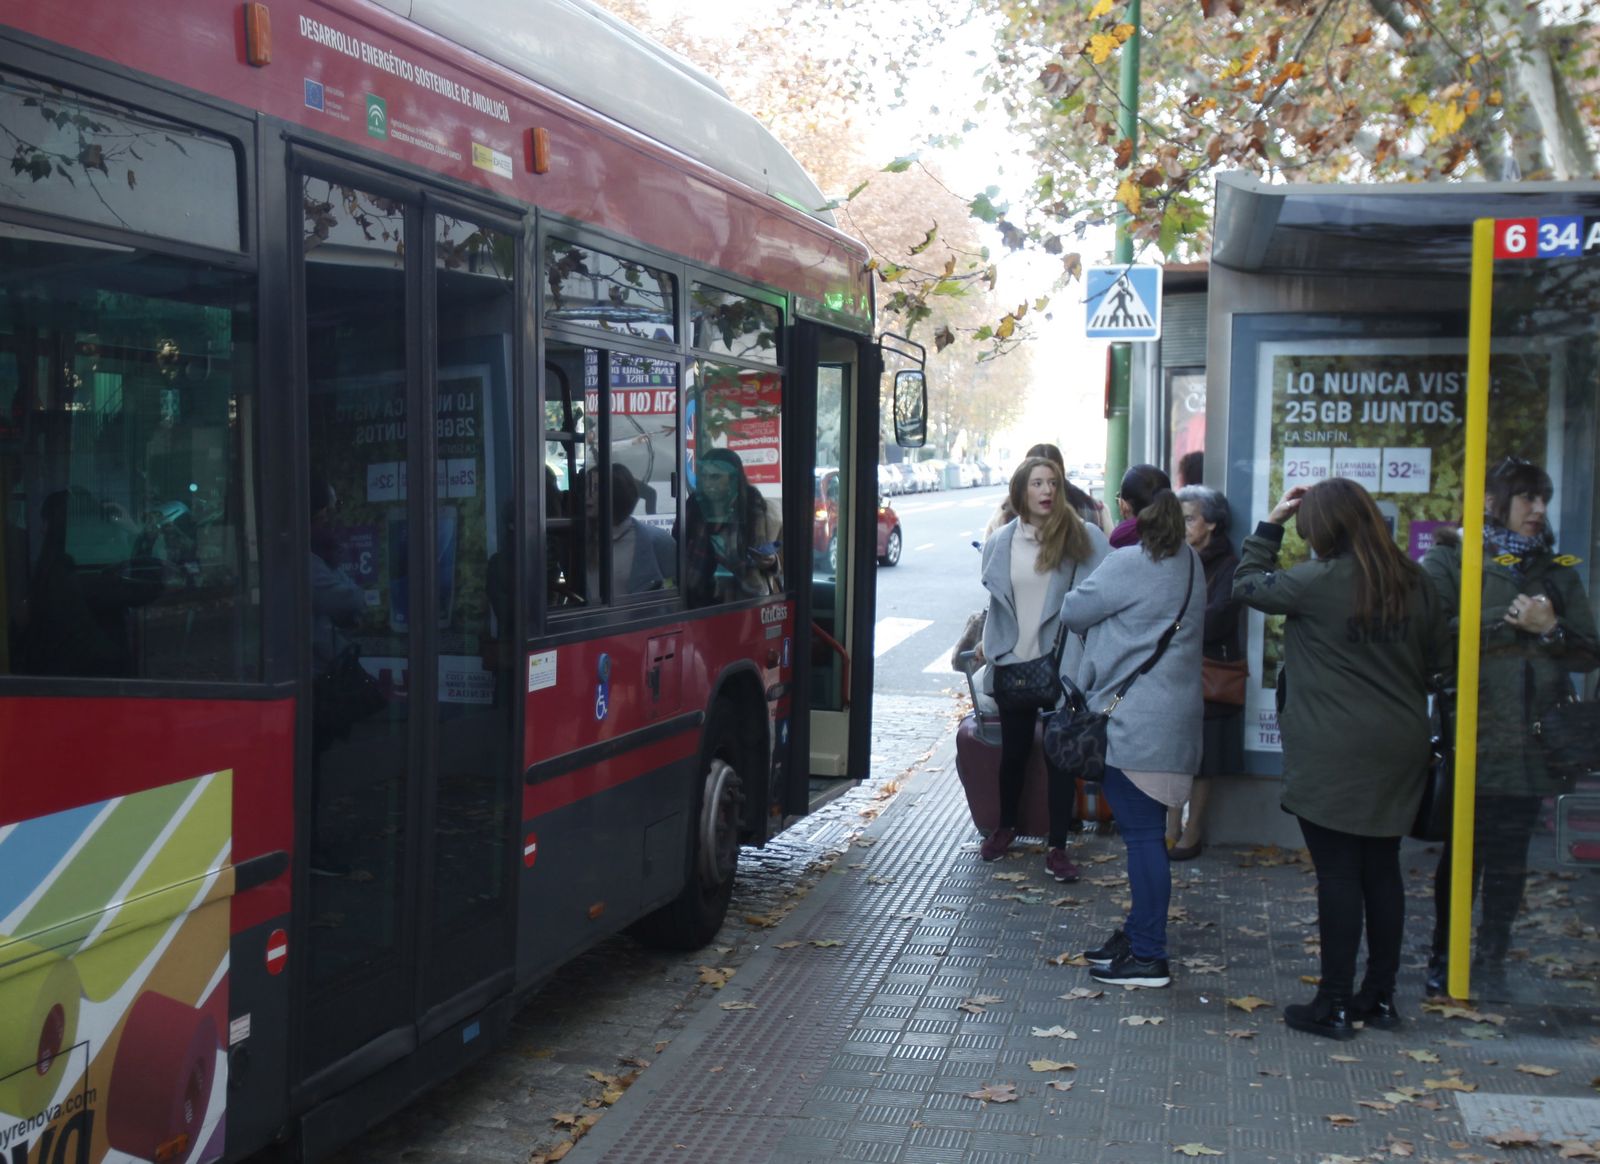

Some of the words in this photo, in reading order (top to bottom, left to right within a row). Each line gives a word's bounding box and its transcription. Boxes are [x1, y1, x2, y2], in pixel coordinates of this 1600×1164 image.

[299, 14, 360, 60] DESARROLLO
[414, 65, 460, 102] SOSTENIBLE
[461, 85, 472, 106] DE
[1505, 224, 1527, 253] 6
[1539, 222, 1579, 251] 34
[1286, 371, 1315, 394] LO
[1324, 371, 1410, 394] NUNCA
[1360, 400, 1463, 424] JUNTOS.
[1284, 431, 1300, 442] LA
[1387, 461, 1412, 479] 32
